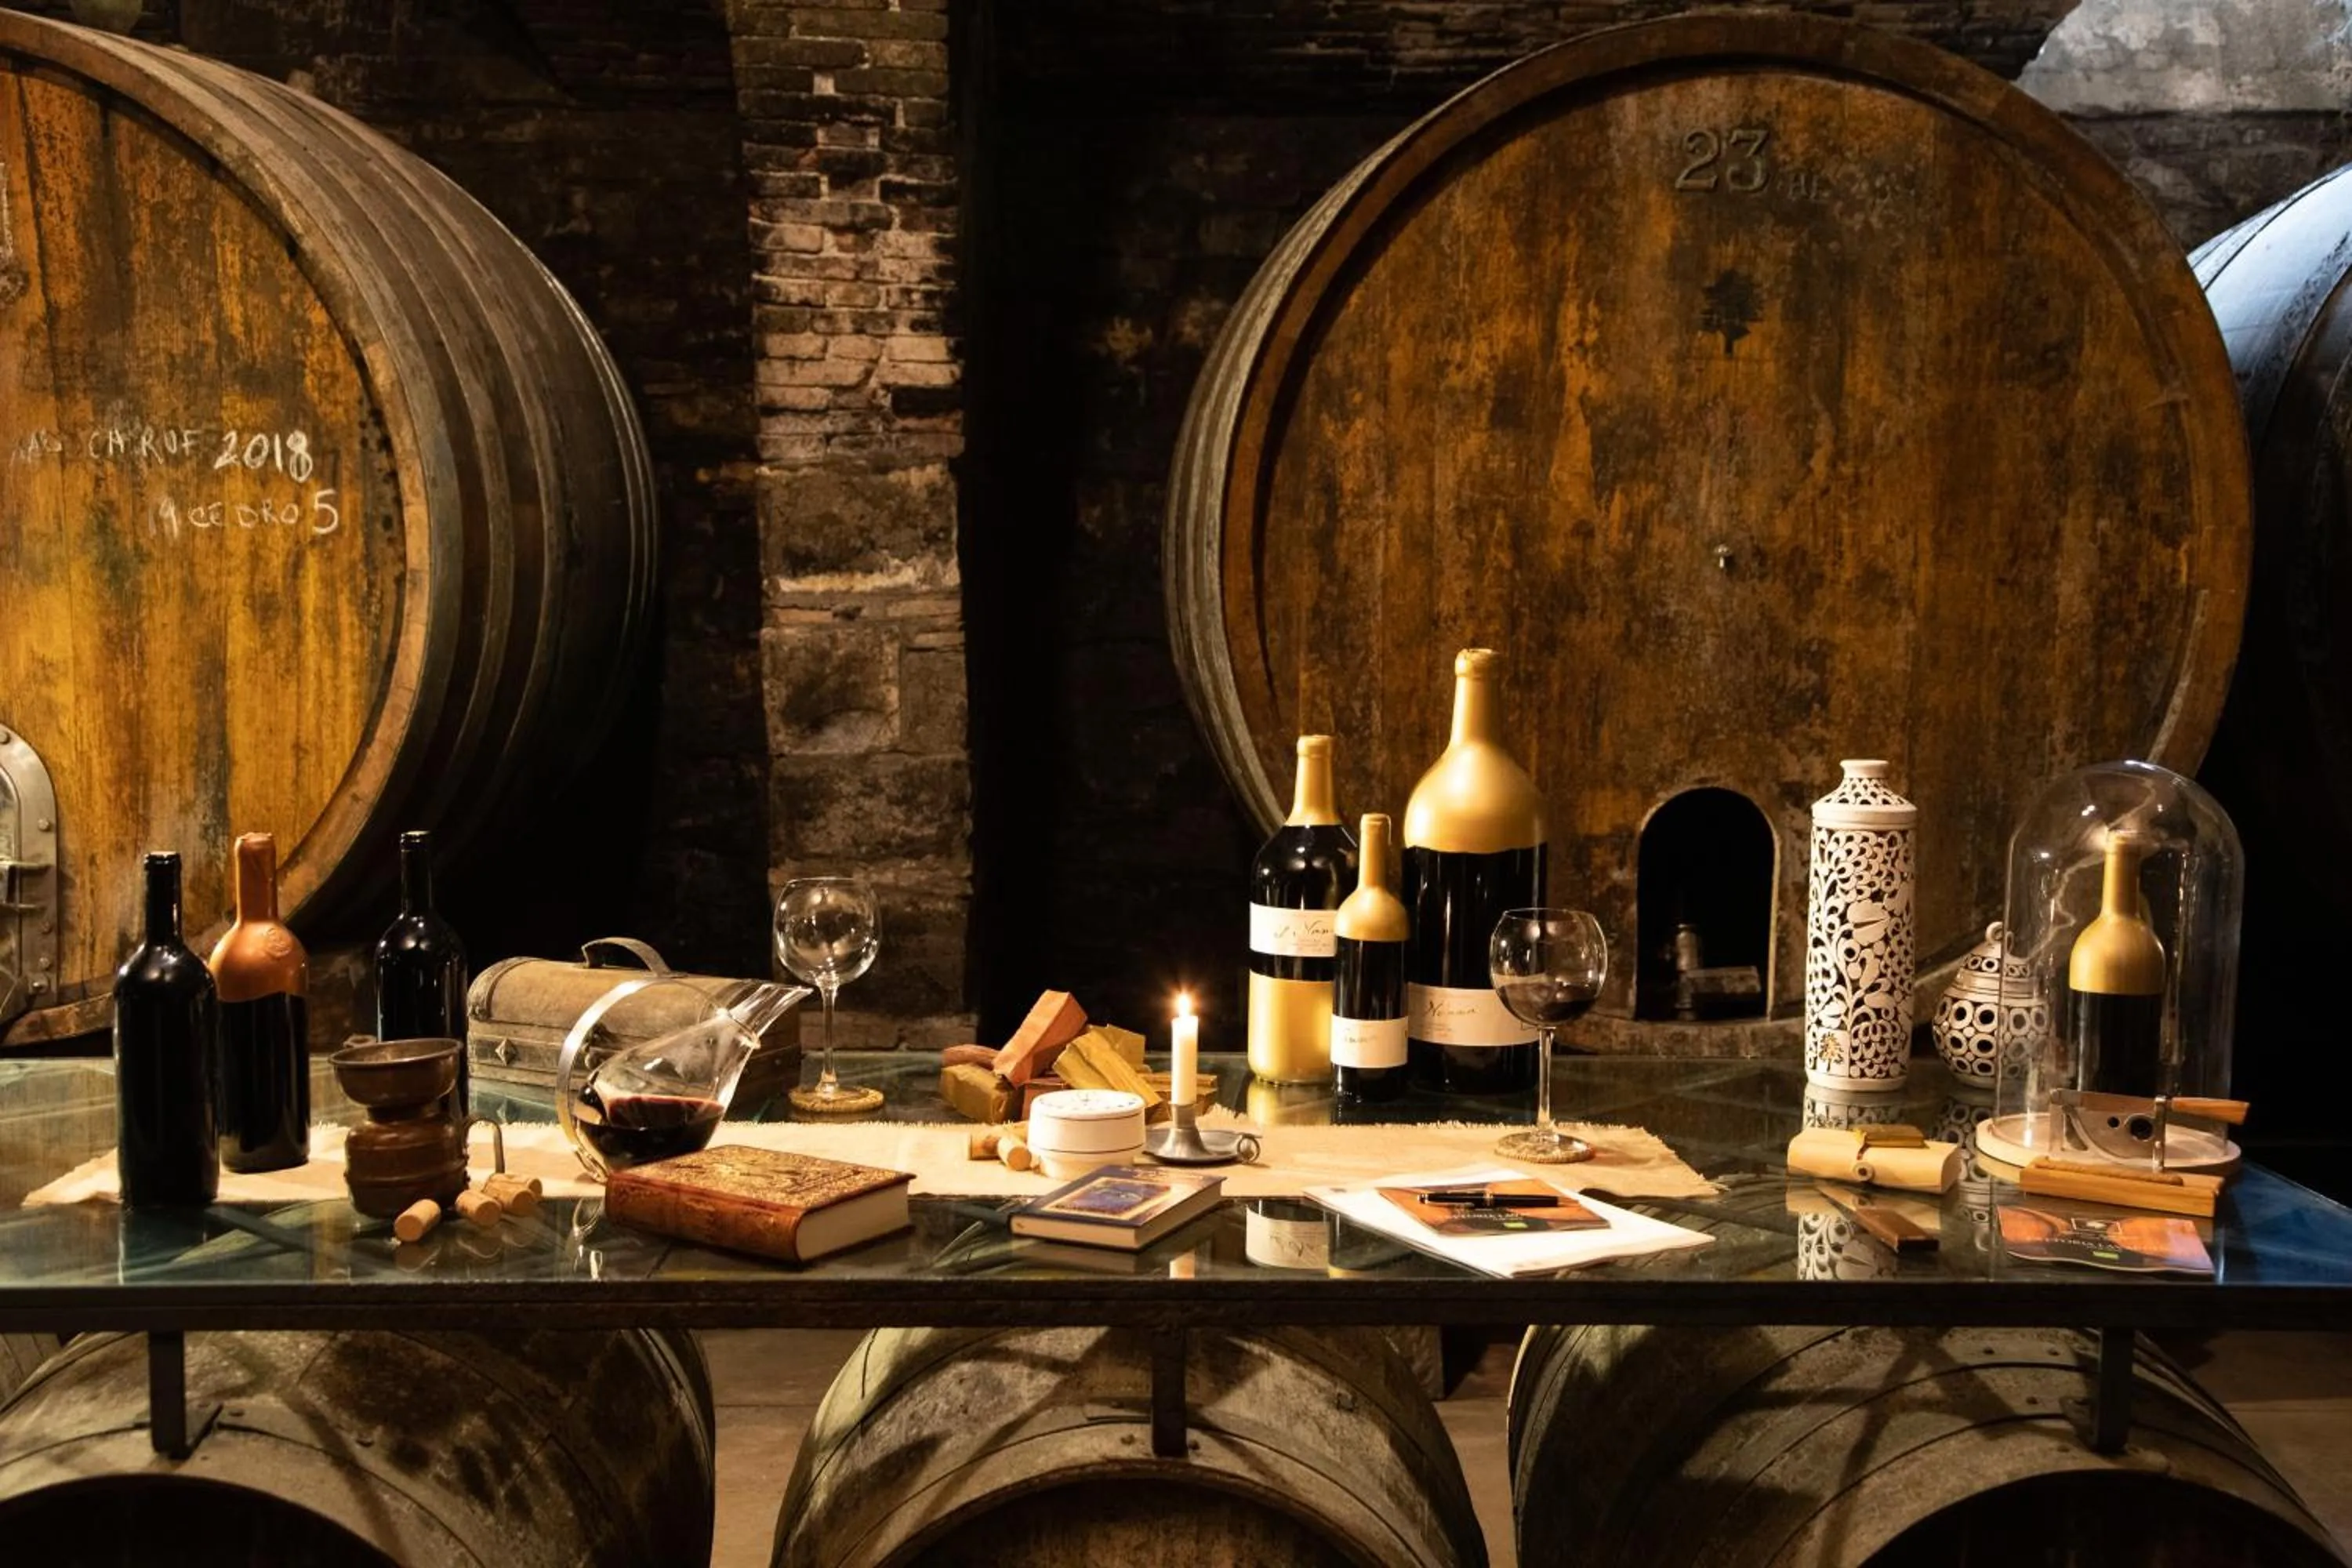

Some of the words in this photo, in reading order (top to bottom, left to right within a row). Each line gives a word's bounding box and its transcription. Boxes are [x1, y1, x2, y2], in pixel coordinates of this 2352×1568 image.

[1674, 129, 1771, 194] 23
[213, 430, 313, 484] 2018
[312, 488, 339, 534] 5
